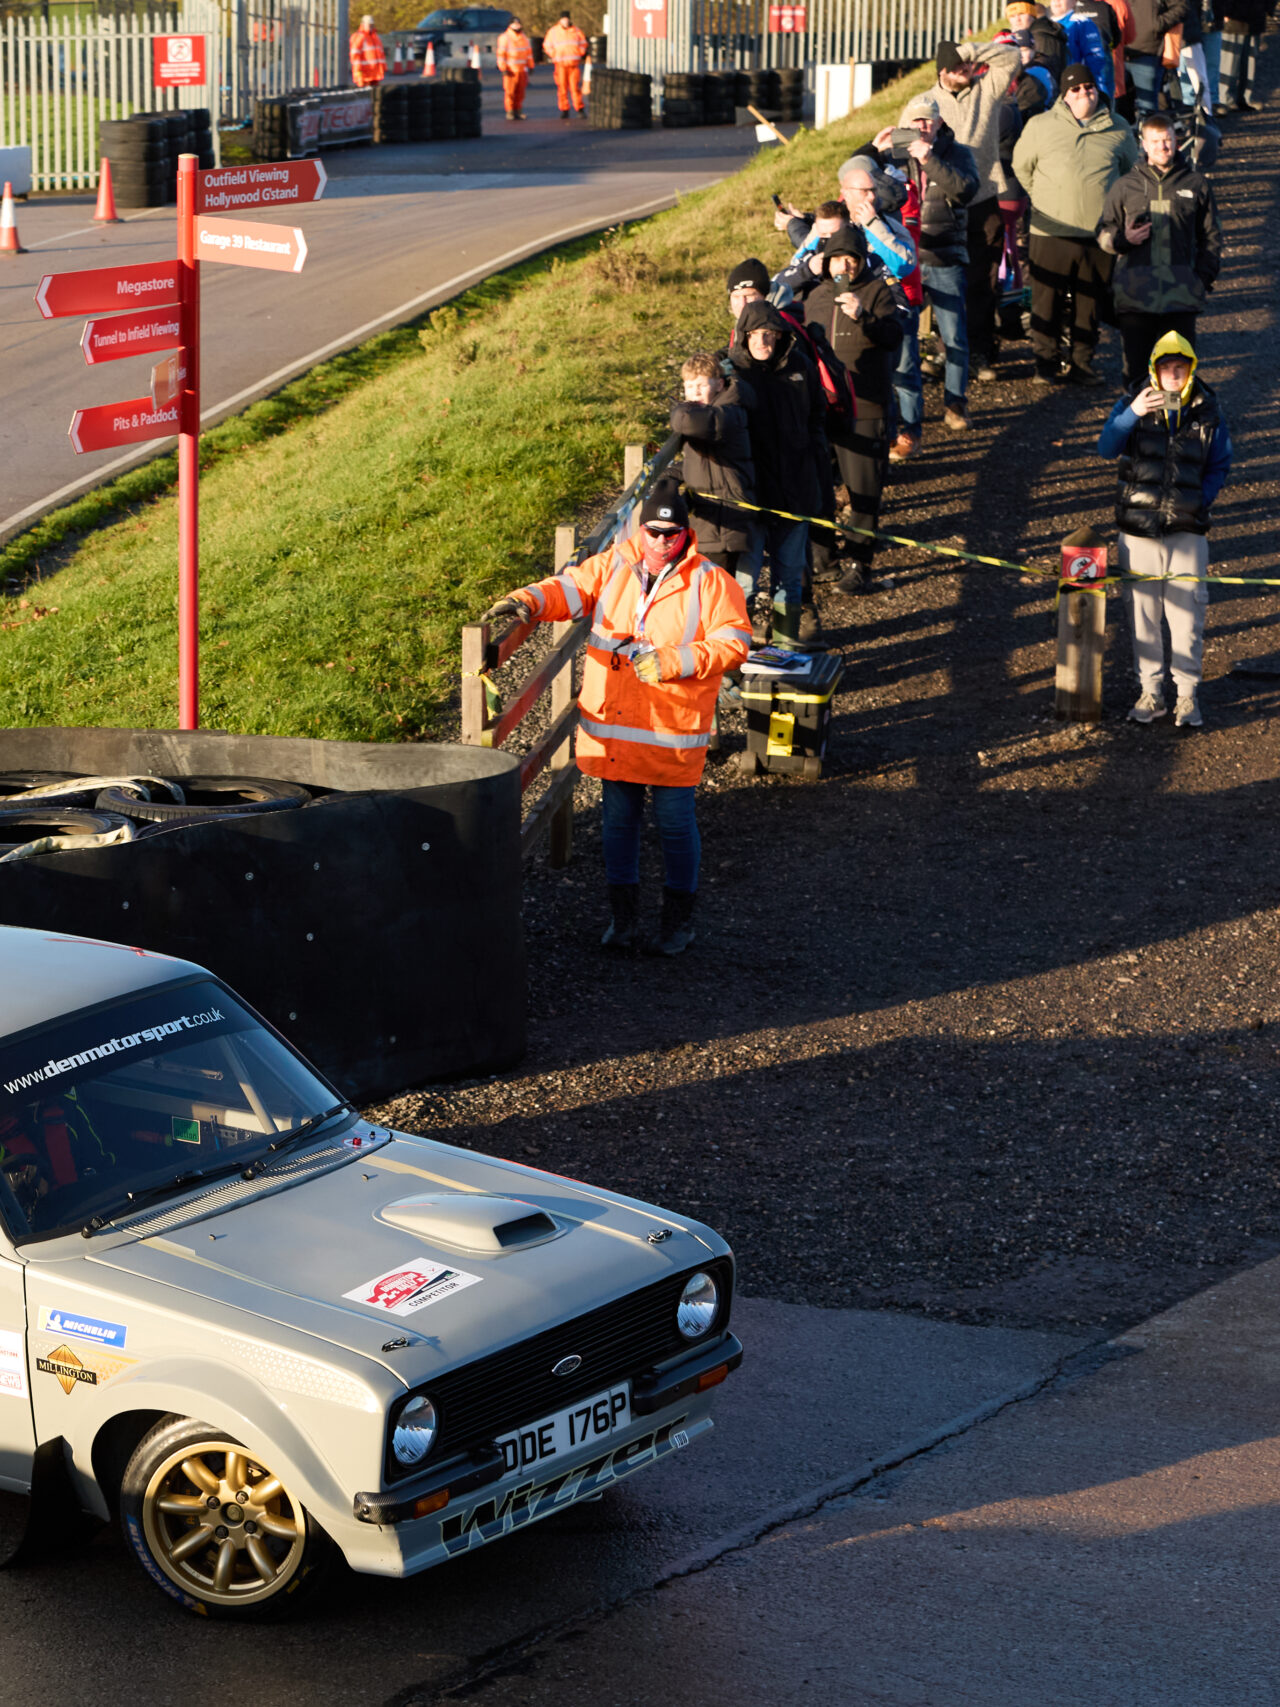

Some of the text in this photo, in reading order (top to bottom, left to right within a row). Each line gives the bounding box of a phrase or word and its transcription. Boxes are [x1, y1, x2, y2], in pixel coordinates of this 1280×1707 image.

[643, 12, 653, 35] 1
[204, 167, 289, 188] Outfield Viewing
[205, 184, 299, 208] Hollywood G'stand
[200, 230, 291, 255] Garage 39 Restaurant
[116, 278, 175, 296] Megastore
[93, 320, 180, 348] Tunnel to Infield Viewing
[113, 406, 178, 432] Pits & Paddock
[3, 1006, 226, 1095] www.denmotorsport.co.uk
[408, 1281, 460, 1308] COMPETITOR
[63, 1319, 118, 1340] MICHELIN
[38, 1359, 93, 1382] MILLINGTON
[504, 1391, 626, 1474] DDE 176P
